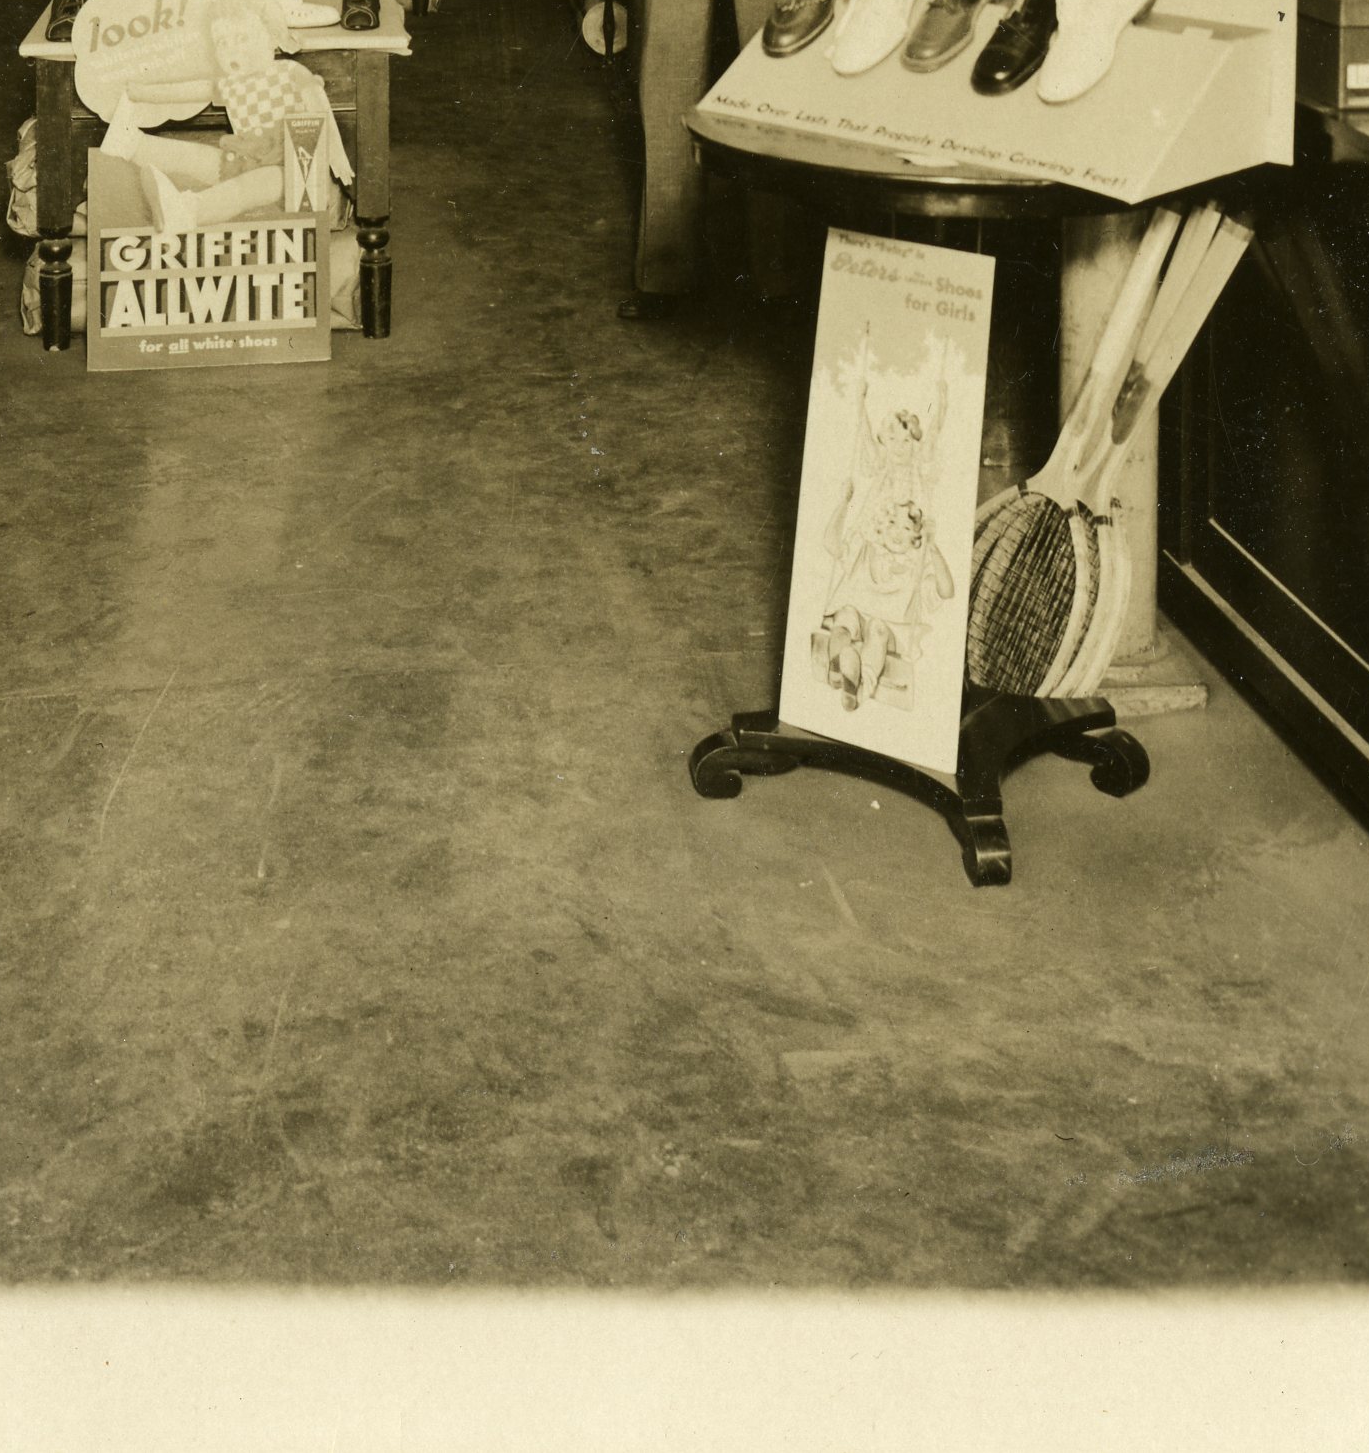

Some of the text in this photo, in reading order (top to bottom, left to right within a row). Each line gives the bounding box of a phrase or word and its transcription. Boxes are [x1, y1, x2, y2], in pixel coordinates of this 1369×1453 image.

[291, 119, 320, 128] GRIFFIN
[711, 95, 751, 109] Made
[757, 102, 790, 116] Over
[795, 110, 830, 125] Lasts
[836, 117, 869, 133] That
[873, 125, 931, 146] Properly
[1009, 151, 1074, 176] Growing
[109, 227, 305, 273] GRIFFIN
[108, 272, 305, 329] ALLWITE
[935, 277, 984, 300] Shoes
[905, 293, 976, 323] for Girls
[138, 335, 278, 353] for all white shoes
